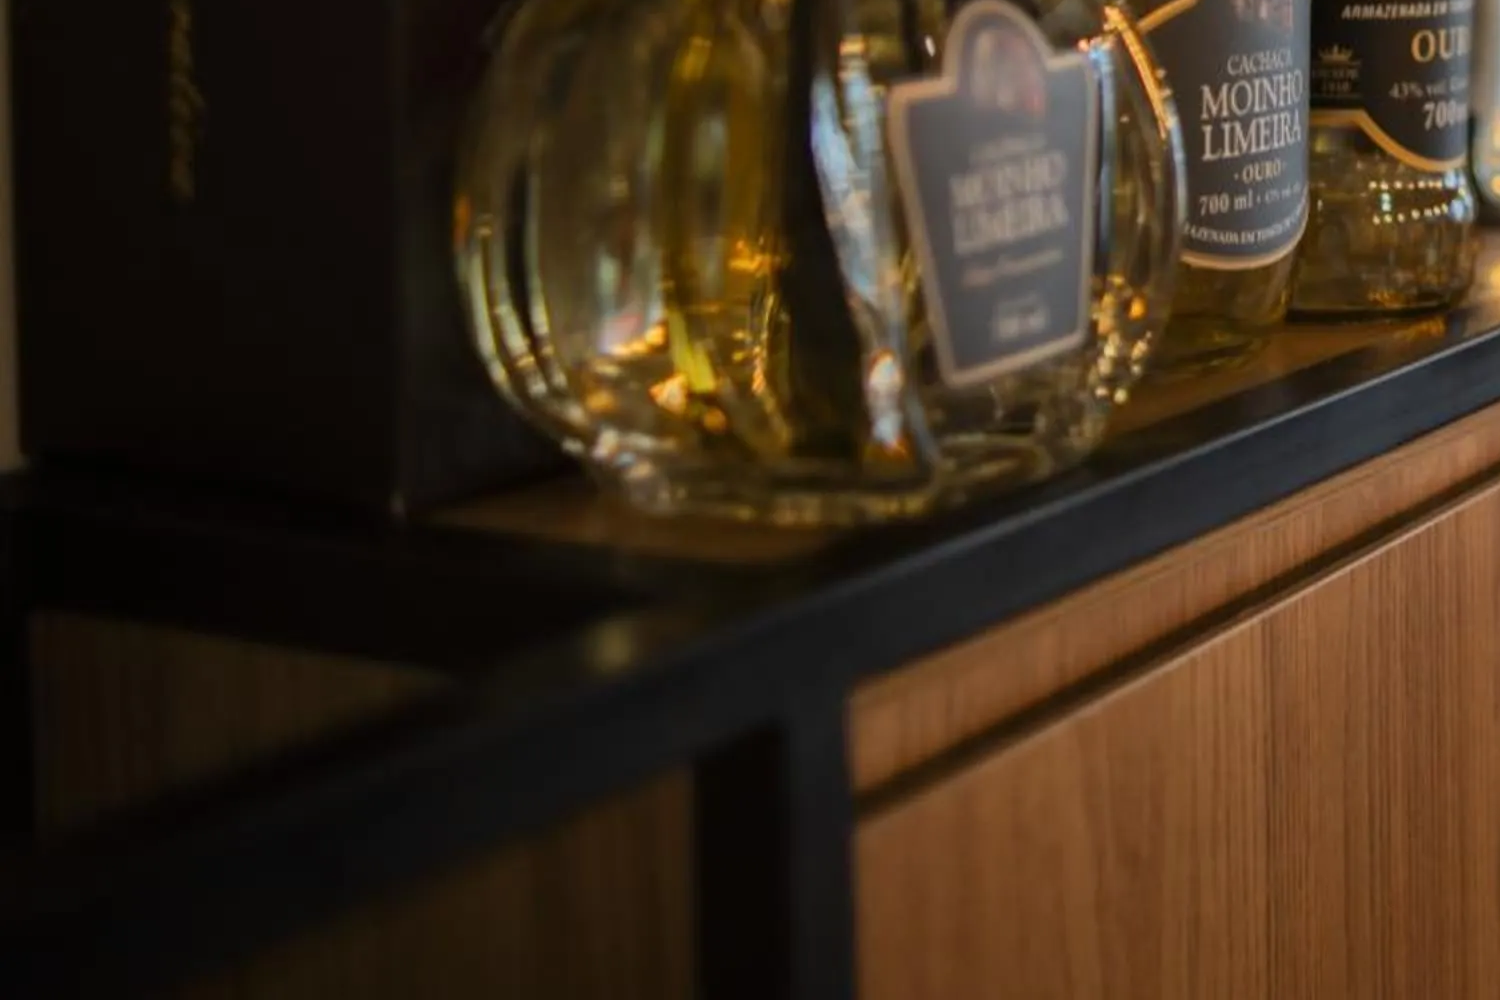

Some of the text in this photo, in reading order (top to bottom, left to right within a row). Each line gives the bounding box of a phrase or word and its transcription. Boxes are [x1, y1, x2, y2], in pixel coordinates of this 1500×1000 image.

[1200, 68, 1303, 119] MOINHO
[1201, 108, 1302, 161] LIMEIRA
[1200, 192, 1230, 217] 700
[1233, 188, 1254, 212] ml
